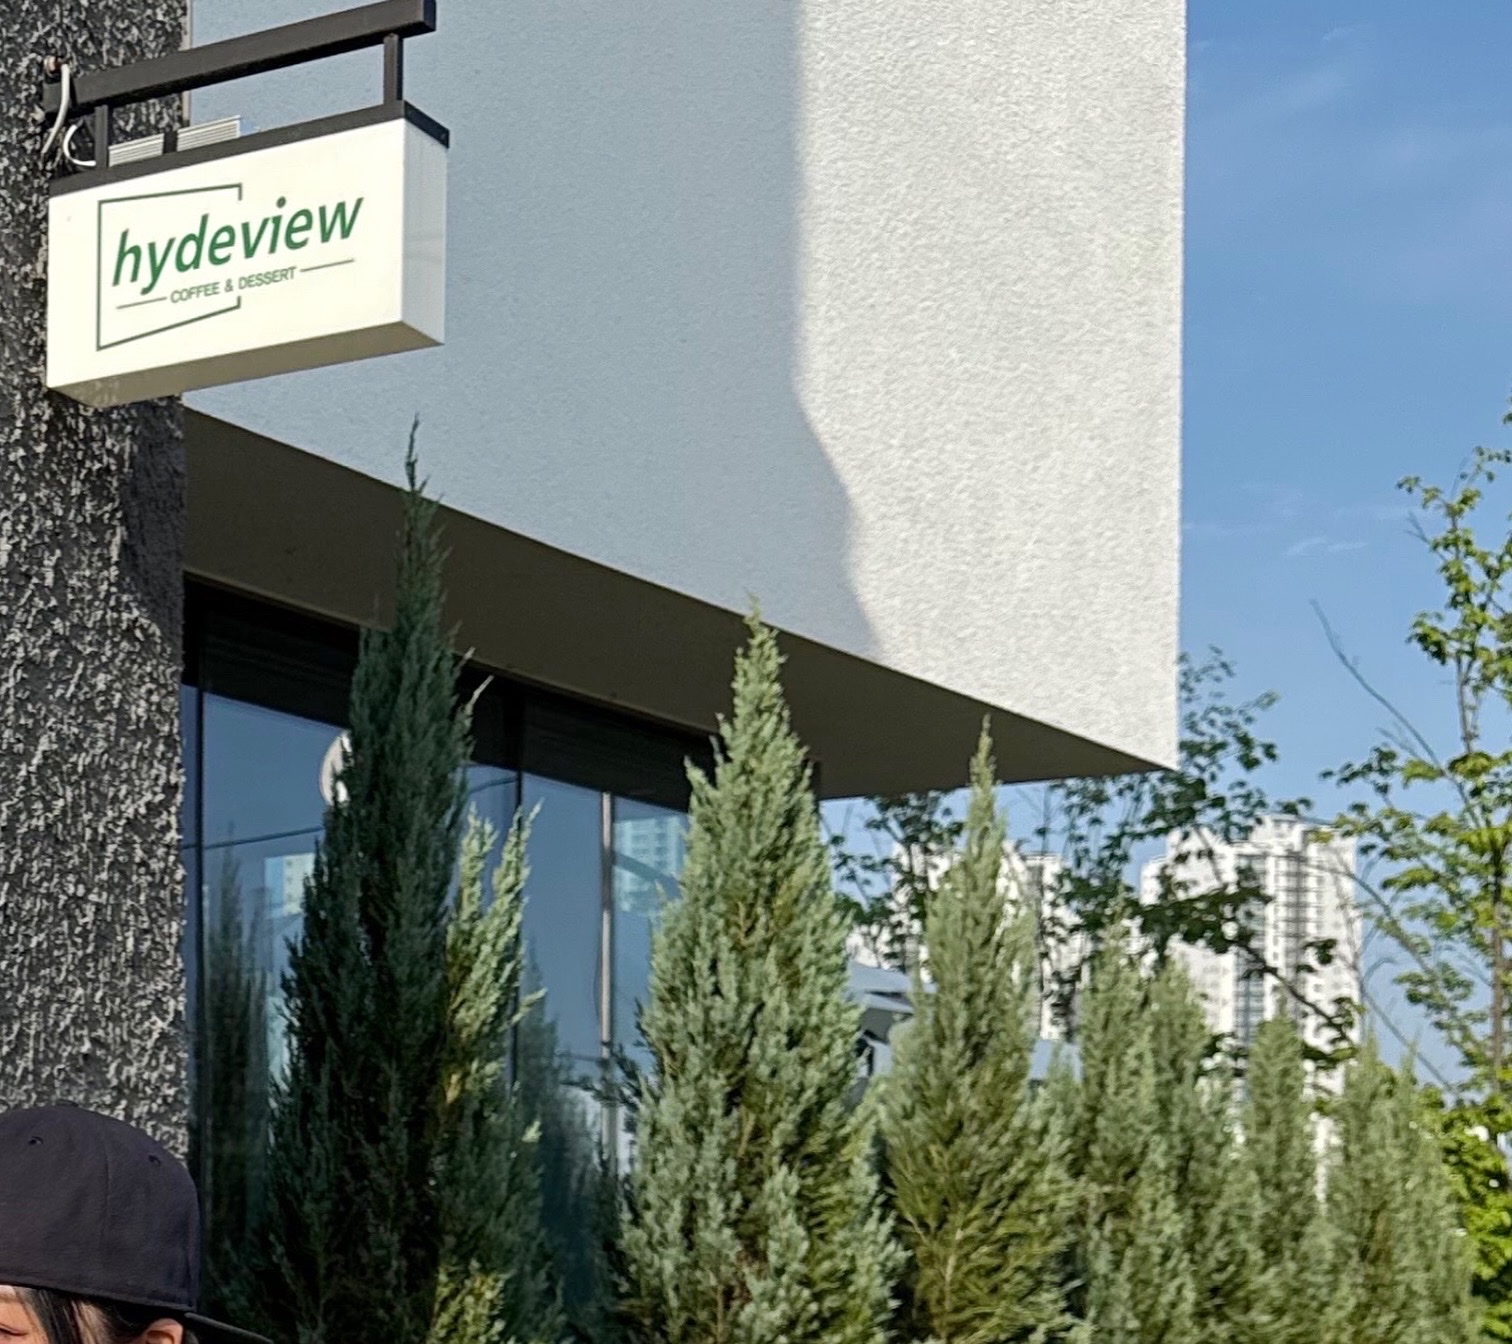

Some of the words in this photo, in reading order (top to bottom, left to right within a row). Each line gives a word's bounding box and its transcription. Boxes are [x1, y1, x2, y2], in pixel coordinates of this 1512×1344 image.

[112, 196, 364, 296] hydeview
[170, 281, 220, 303] COFFEE
[224, 278, 234, 293] &
[238, 266, 297, 290] DESSERT
